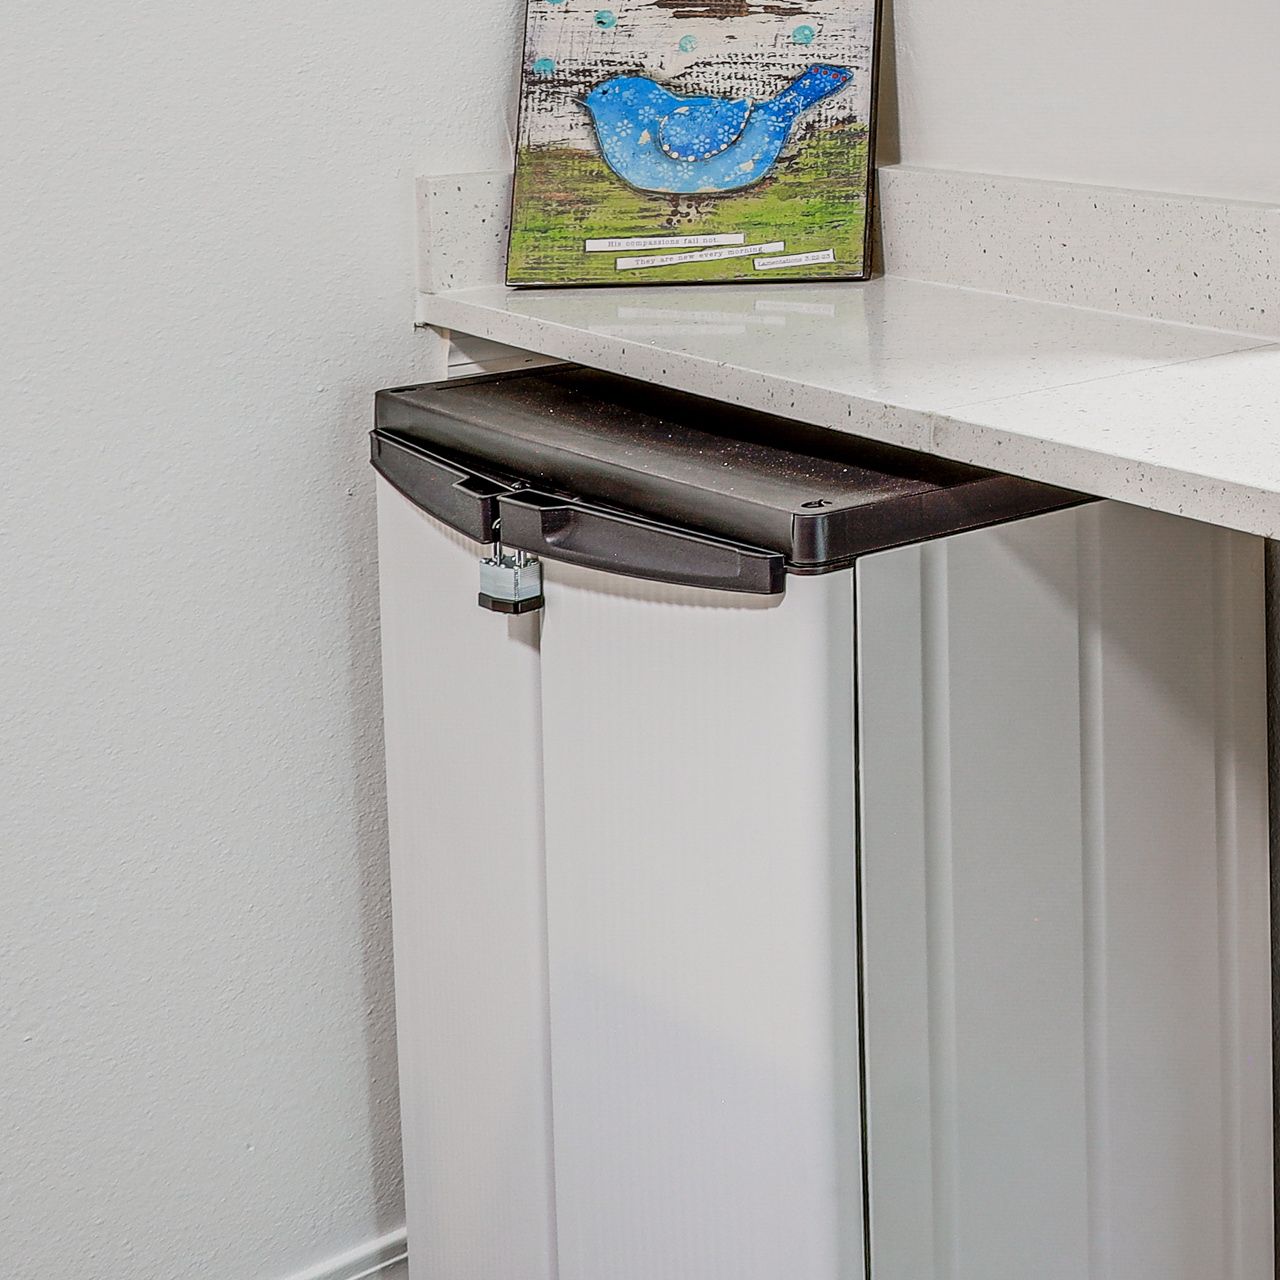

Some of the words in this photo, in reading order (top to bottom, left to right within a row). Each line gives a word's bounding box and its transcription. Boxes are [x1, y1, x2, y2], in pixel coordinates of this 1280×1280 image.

[607, 240, 622, 248] His
[625, 238, 680, 248] compassions
[634, 257, 656, 266] They
[698, 250, 722, 259] every
